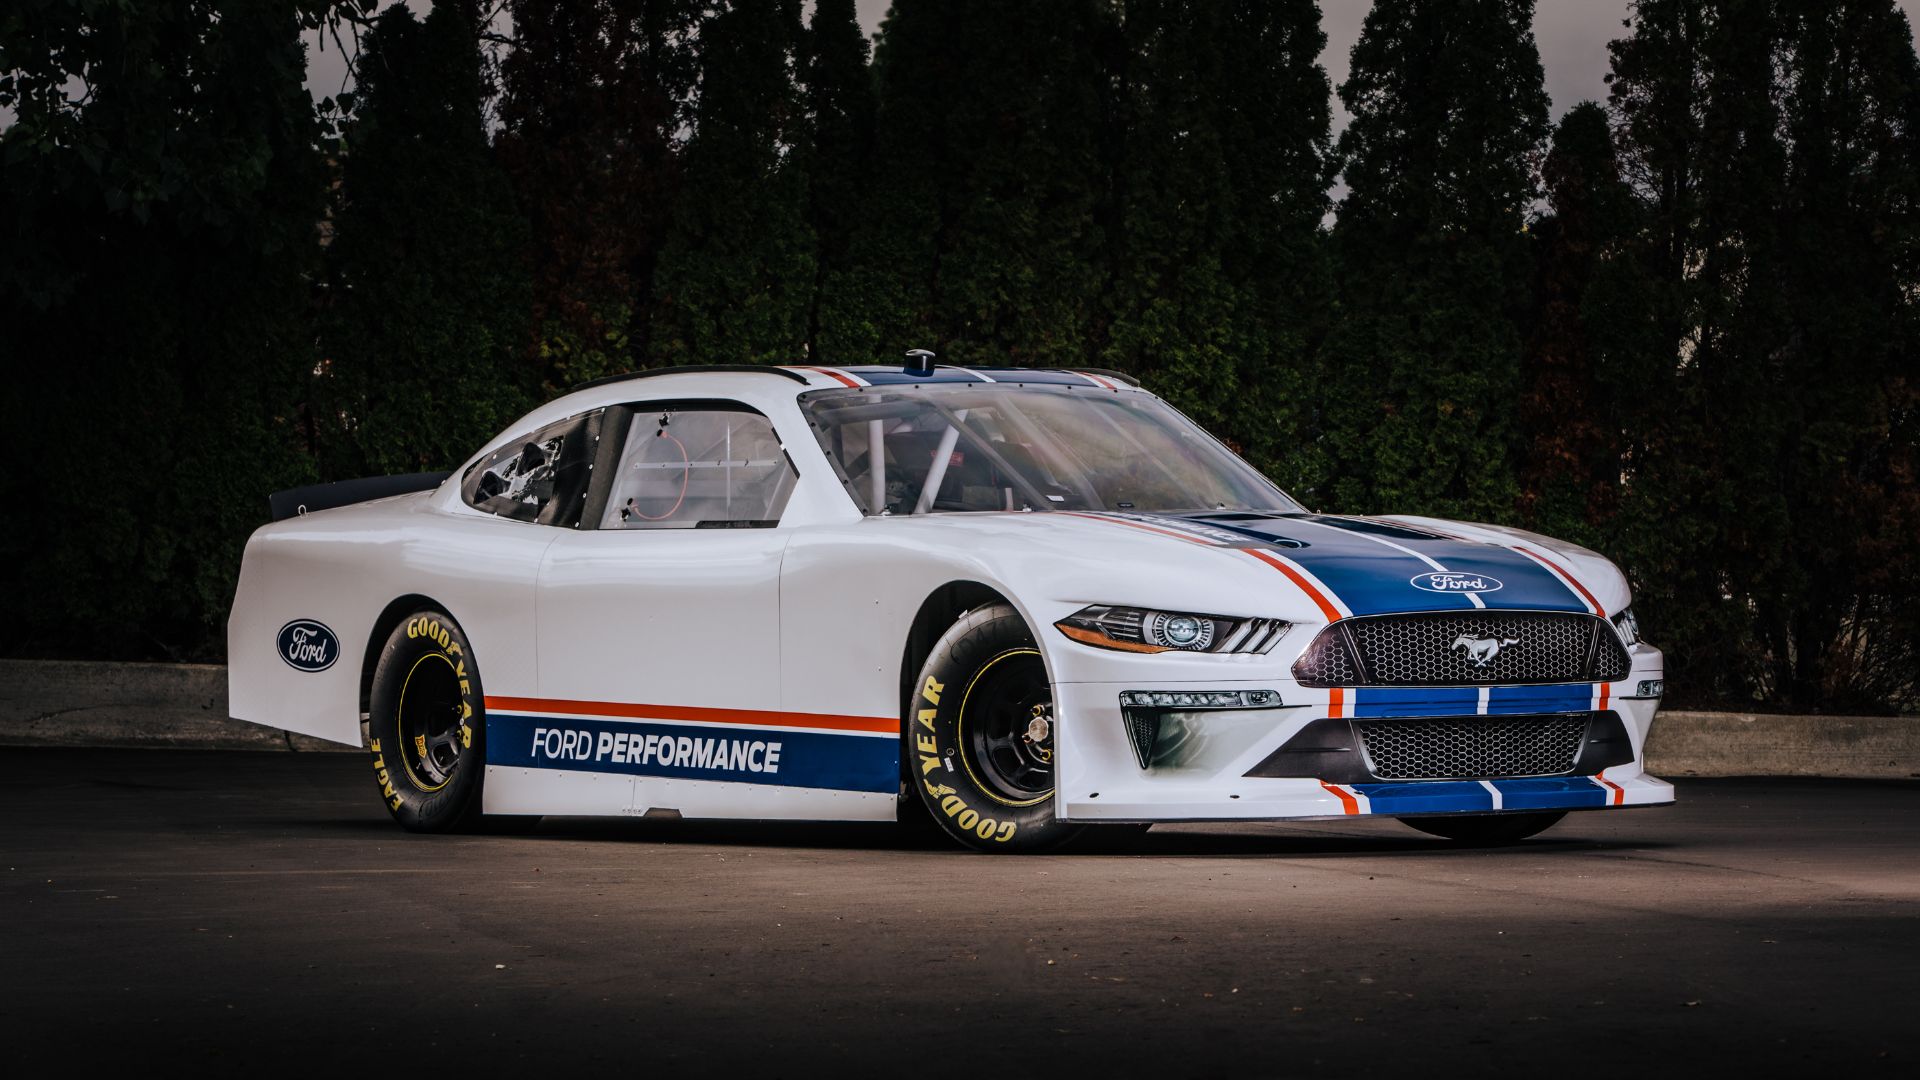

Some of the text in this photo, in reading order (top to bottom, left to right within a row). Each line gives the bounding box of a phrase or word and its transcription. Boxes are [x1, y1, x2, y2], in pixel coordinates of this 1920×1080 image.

[1430, 574, 1487, 590] Ford
[289, 627, 327, 663] Ford
[531, 728, 782, 774] FORD PERFORMANCE
[370, 738, 404, 811] EAGLE
